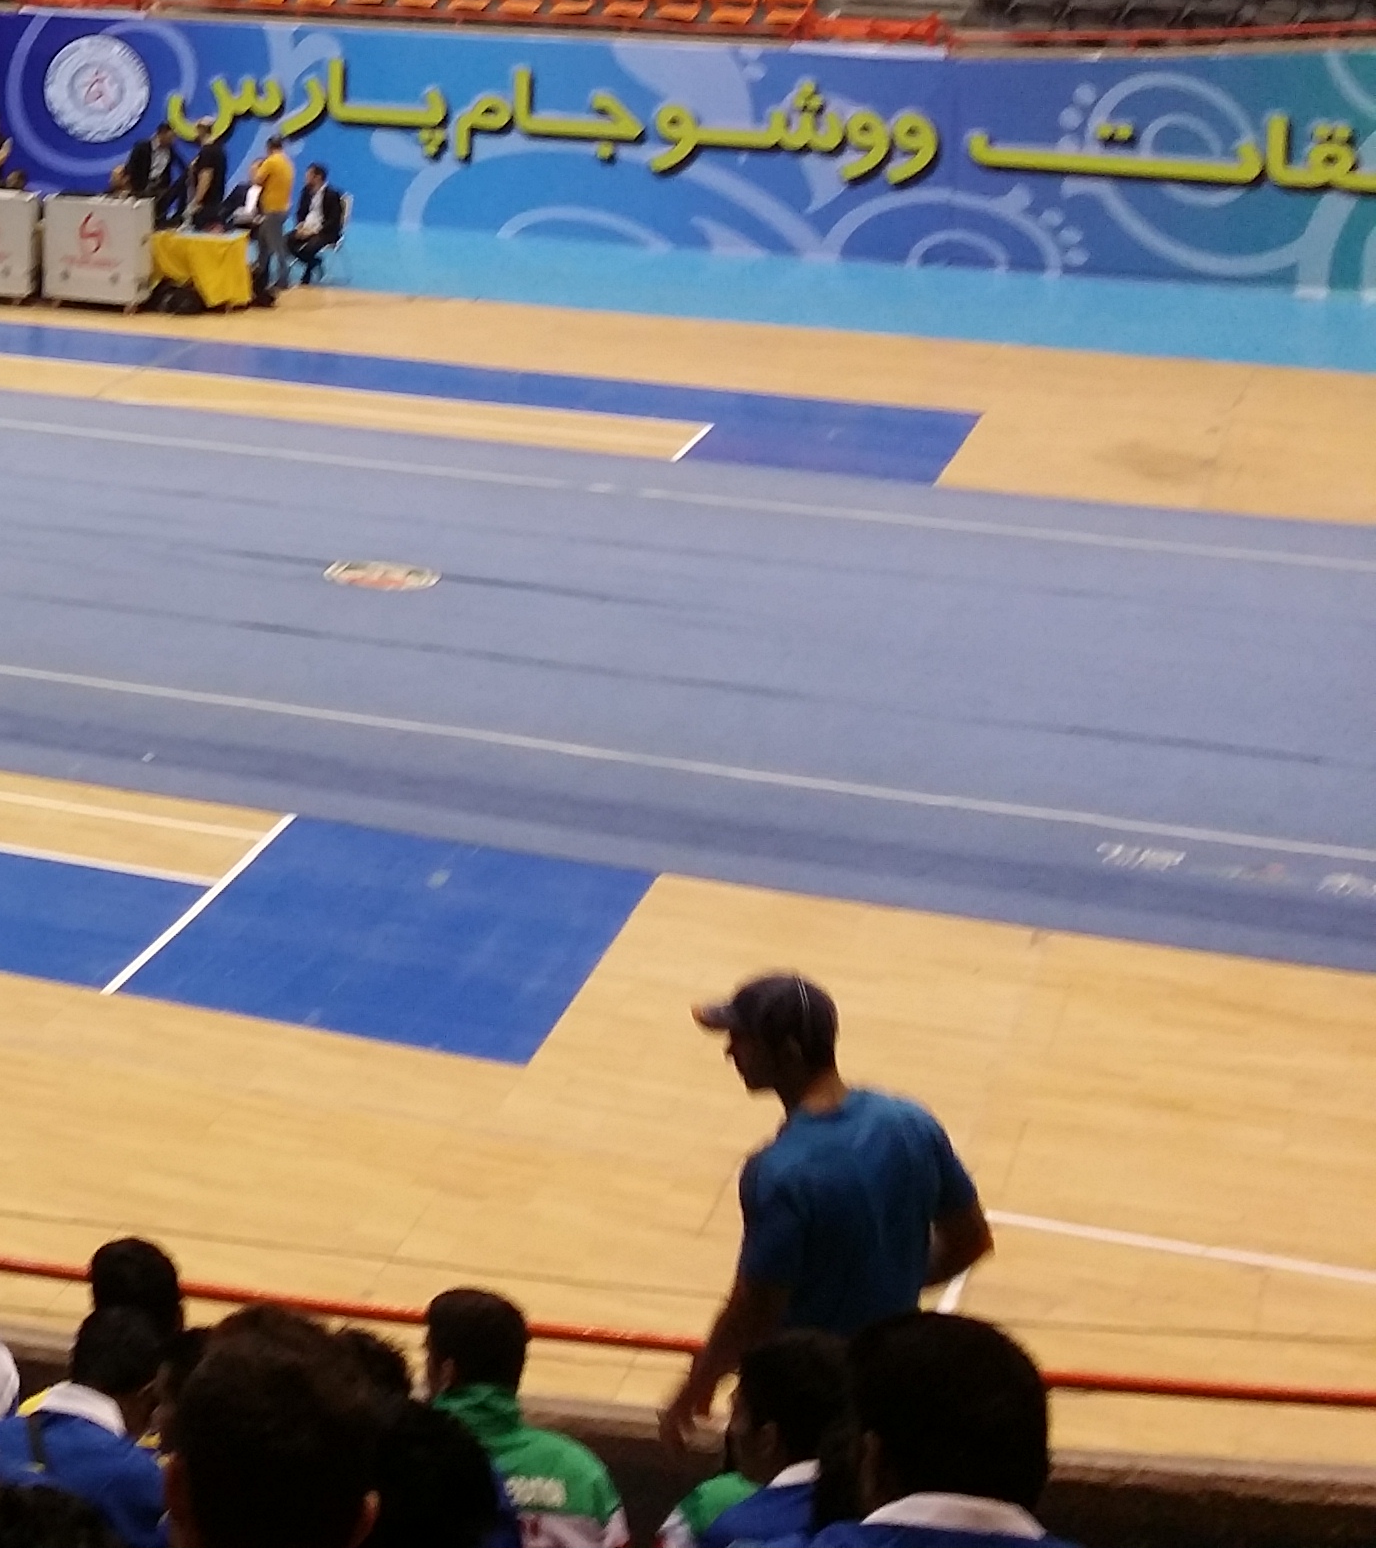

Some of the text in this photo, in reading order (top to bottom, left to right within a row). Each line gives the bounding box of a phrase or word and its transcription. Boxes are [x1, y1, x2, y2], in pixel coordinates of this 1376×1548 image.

[167, 58, 448, 159] پارس
[455, 65, 645, 162] جام
[967, 113, 1376, 194] قات
